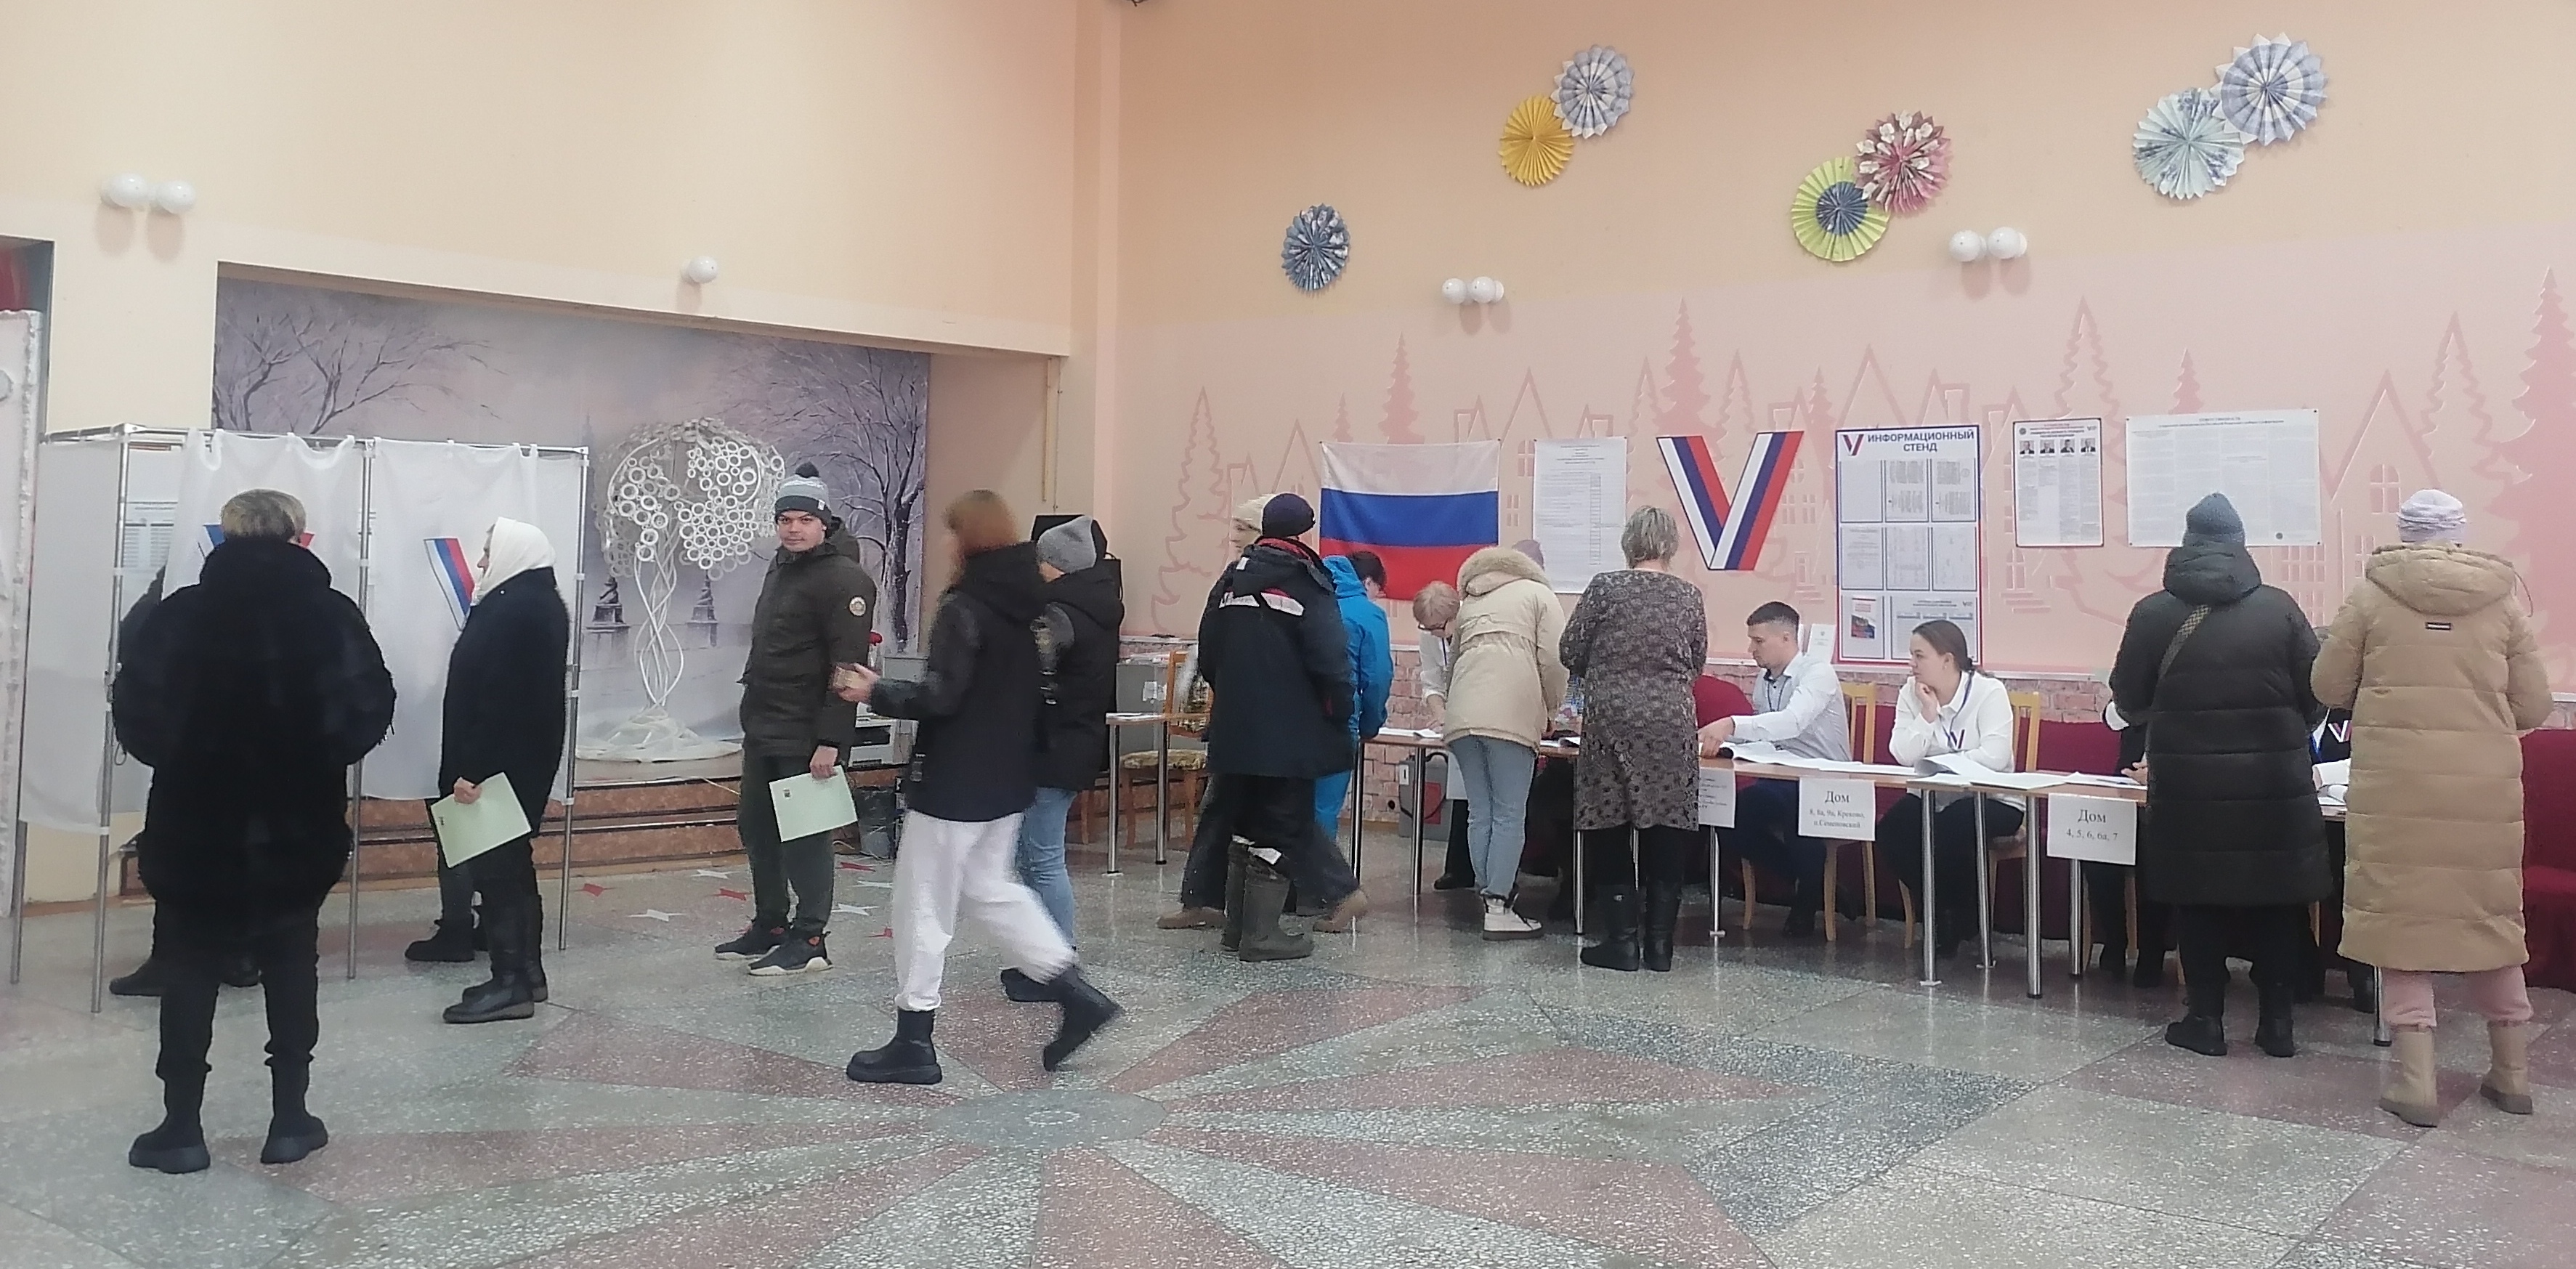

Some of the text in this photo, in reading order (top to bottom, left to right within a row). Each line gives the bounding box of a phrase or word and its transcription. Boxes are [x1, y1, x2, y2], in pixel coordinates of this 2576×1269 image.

[1867, 429, 1974, 443] ИНФОРМАЦИОННЫЙ
[1903, 442, 1937, 453] СТЕНД
[1824, 790, 1850, 804] Дом
[2077, 808, 2107, 824] Дом
[2066, 828, 2118, 841] 4, 5, 6, 6а, 7
